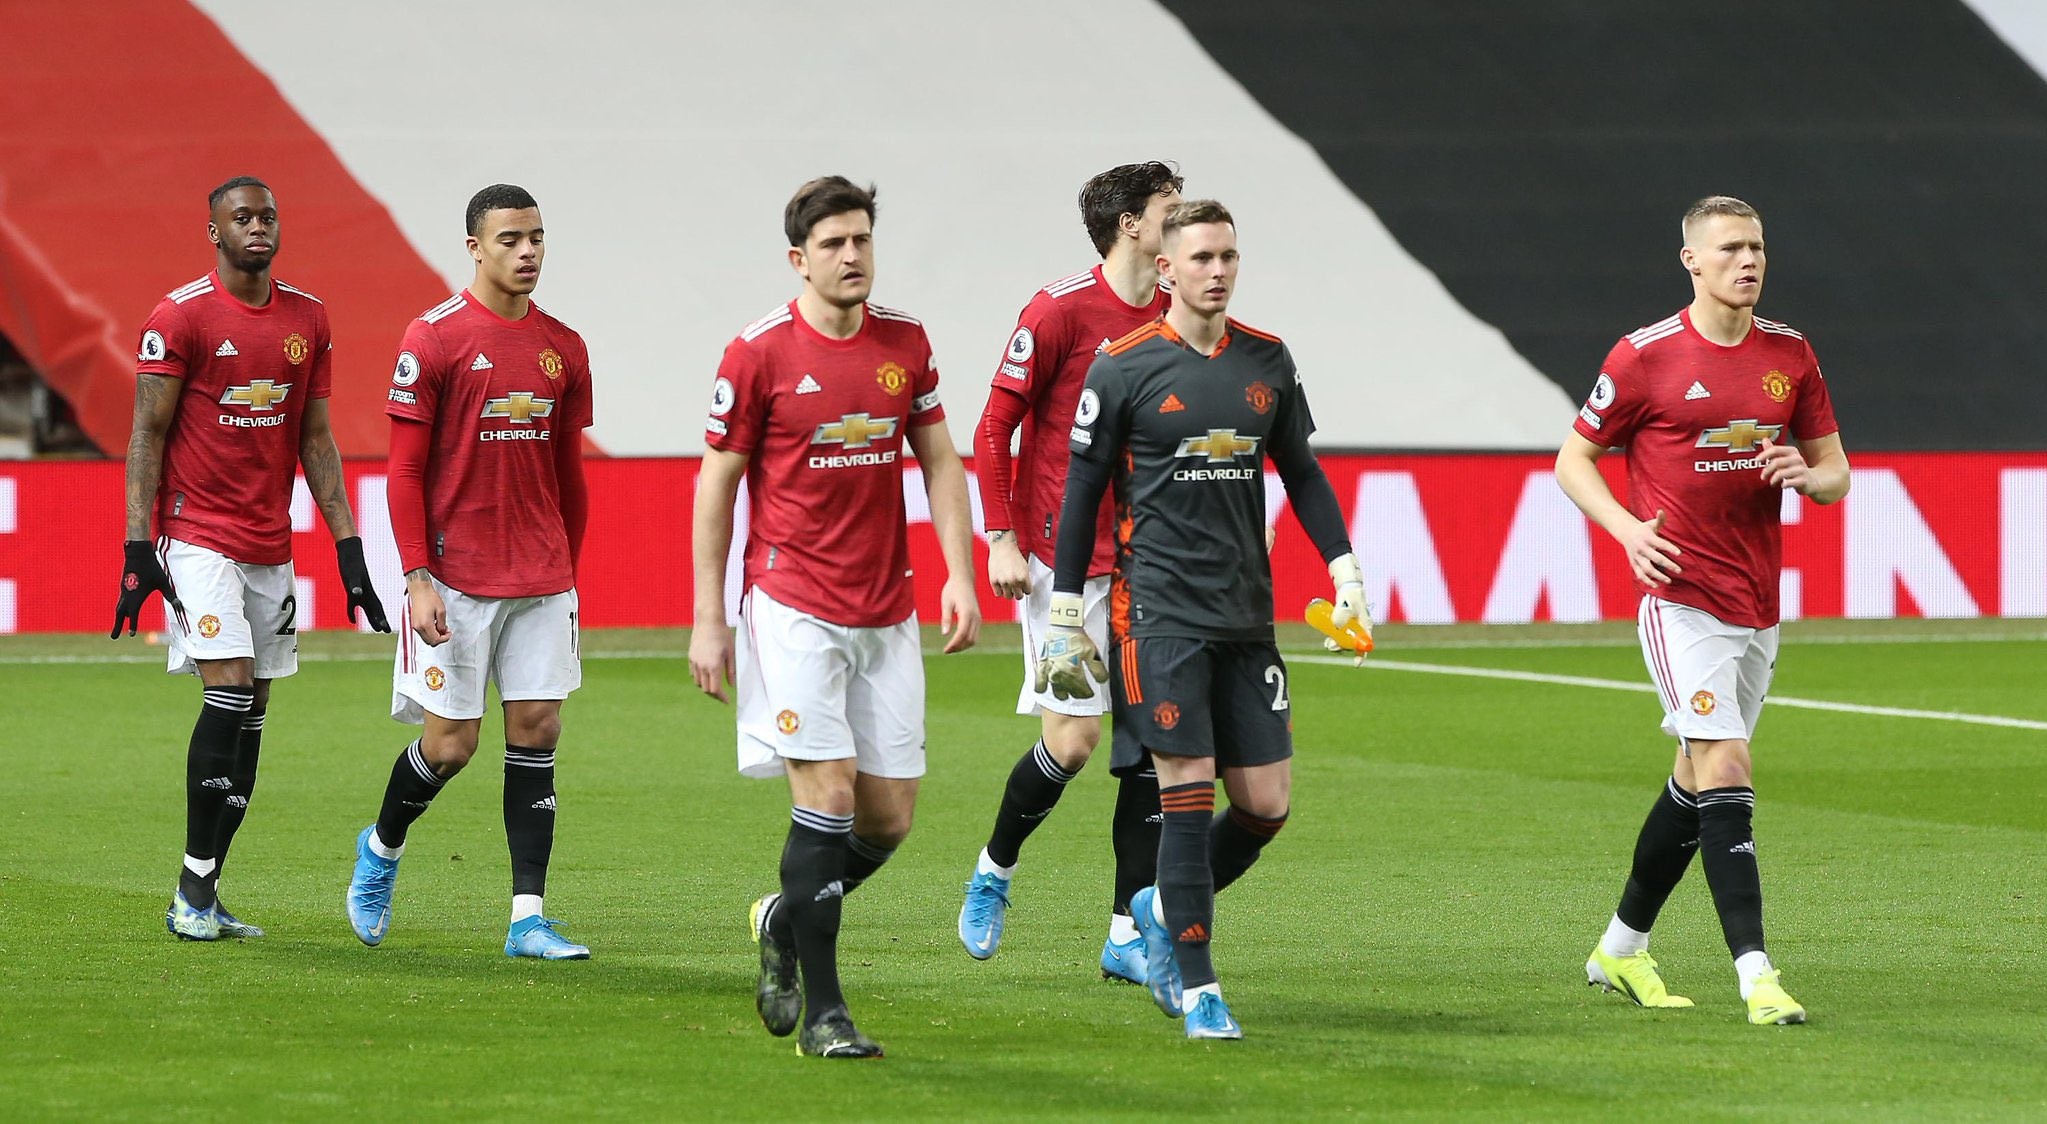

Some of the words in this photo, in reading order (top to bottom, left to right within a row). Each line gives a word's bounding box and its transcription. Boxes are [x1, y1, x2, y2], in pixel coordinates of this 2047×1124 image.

[219, 413, 286, 428] CHEVROLET
[808, 451, 897, 469] CHEVROLET
[1173, 469, 1256, 481] CHEVROLET
[275, 595, 296, 635] 2
[1264, 665, 1289, 711] 2
